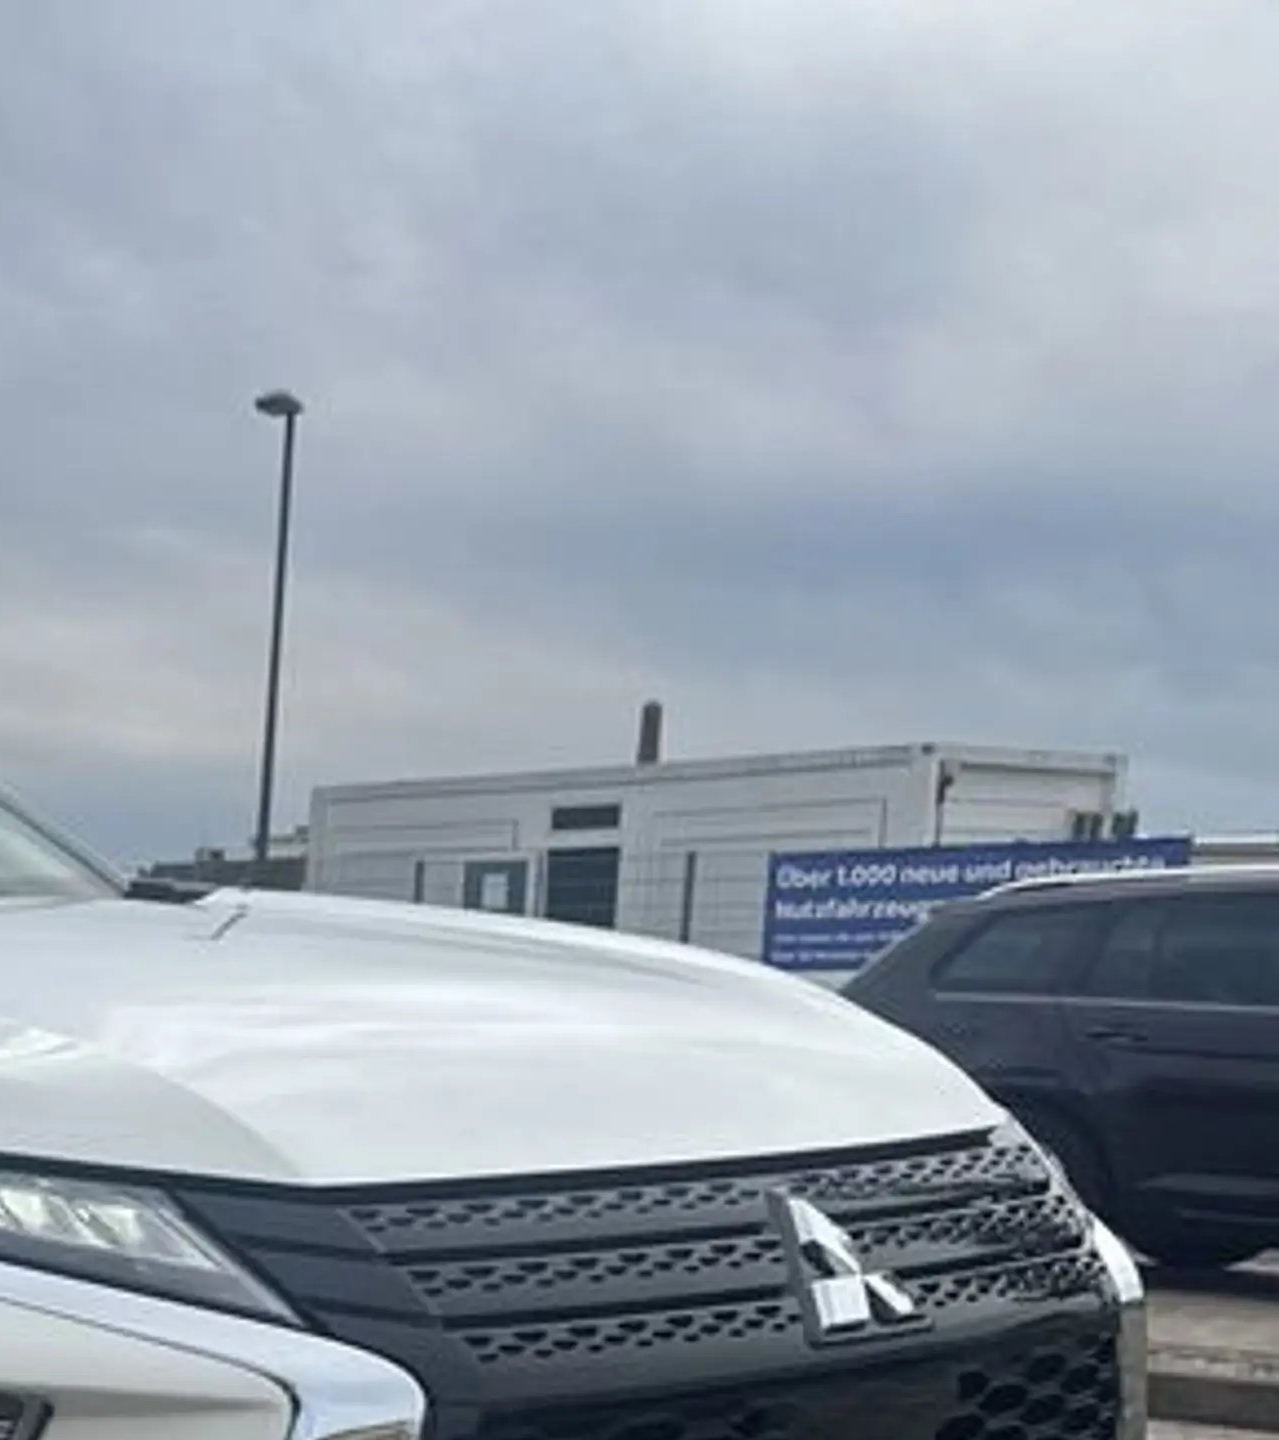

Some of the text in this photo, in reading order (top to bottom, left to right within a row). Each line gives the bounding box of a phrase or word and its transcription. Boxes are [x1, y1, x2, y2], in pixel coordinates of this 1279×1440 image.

[776, 863, 831, 890] Über
[838, 863, 897, 887] 1.000
[900, 864, 959, 885] neue
[965, 859, 1012, 884] und
[775, 897, 928, 921] Nutzfahrzeug
